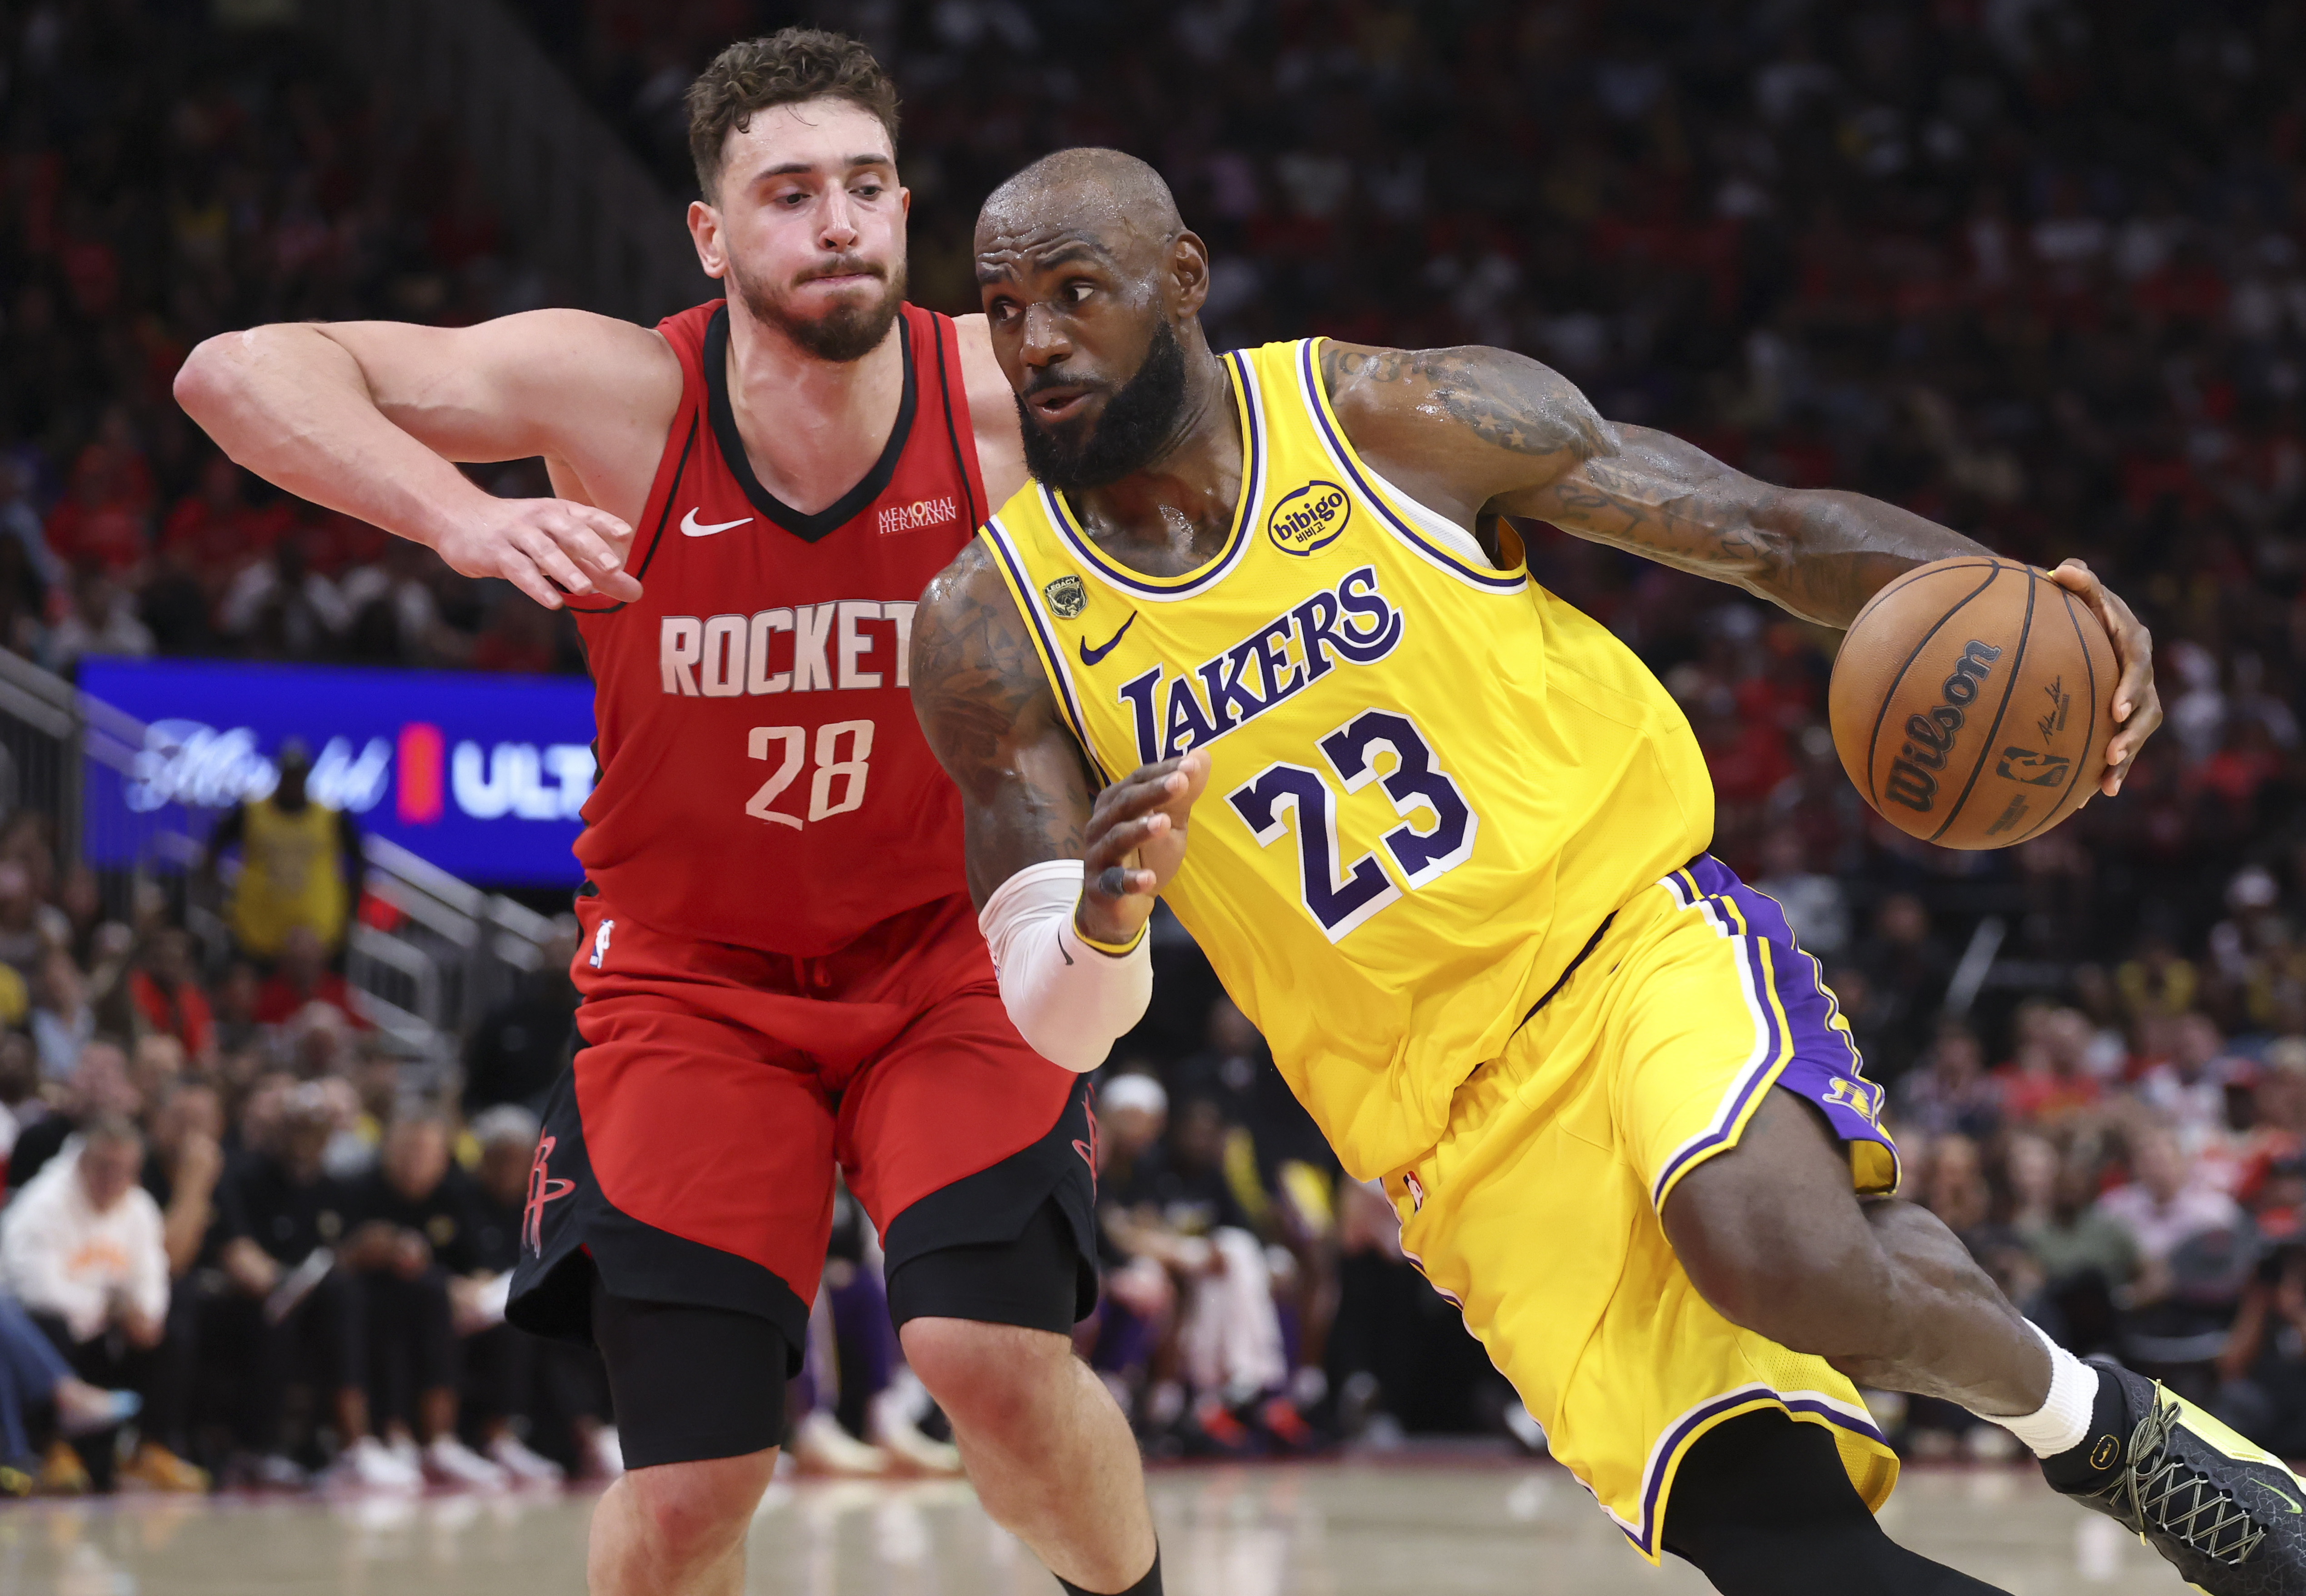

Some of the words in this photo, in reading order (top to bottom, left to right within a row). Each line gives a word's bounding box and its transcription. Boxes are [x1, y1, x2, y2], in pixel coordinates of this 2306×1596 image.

[878, 496, 956, 522] MEMORIAL
[879, 507, 956, 534] HERMANN
[1273, 493, 1343, 541] bibigo
[1296, 521, 1326, 543] 비비고
[1046, 577, 1075, 592] LEGACY
[1117, 564, 1404, 768] LAKERS
[1885, 639, 2002, 812] Wilson
[745, 719, 875, 831] 28
[1223, 706, 1480, 945] 23
